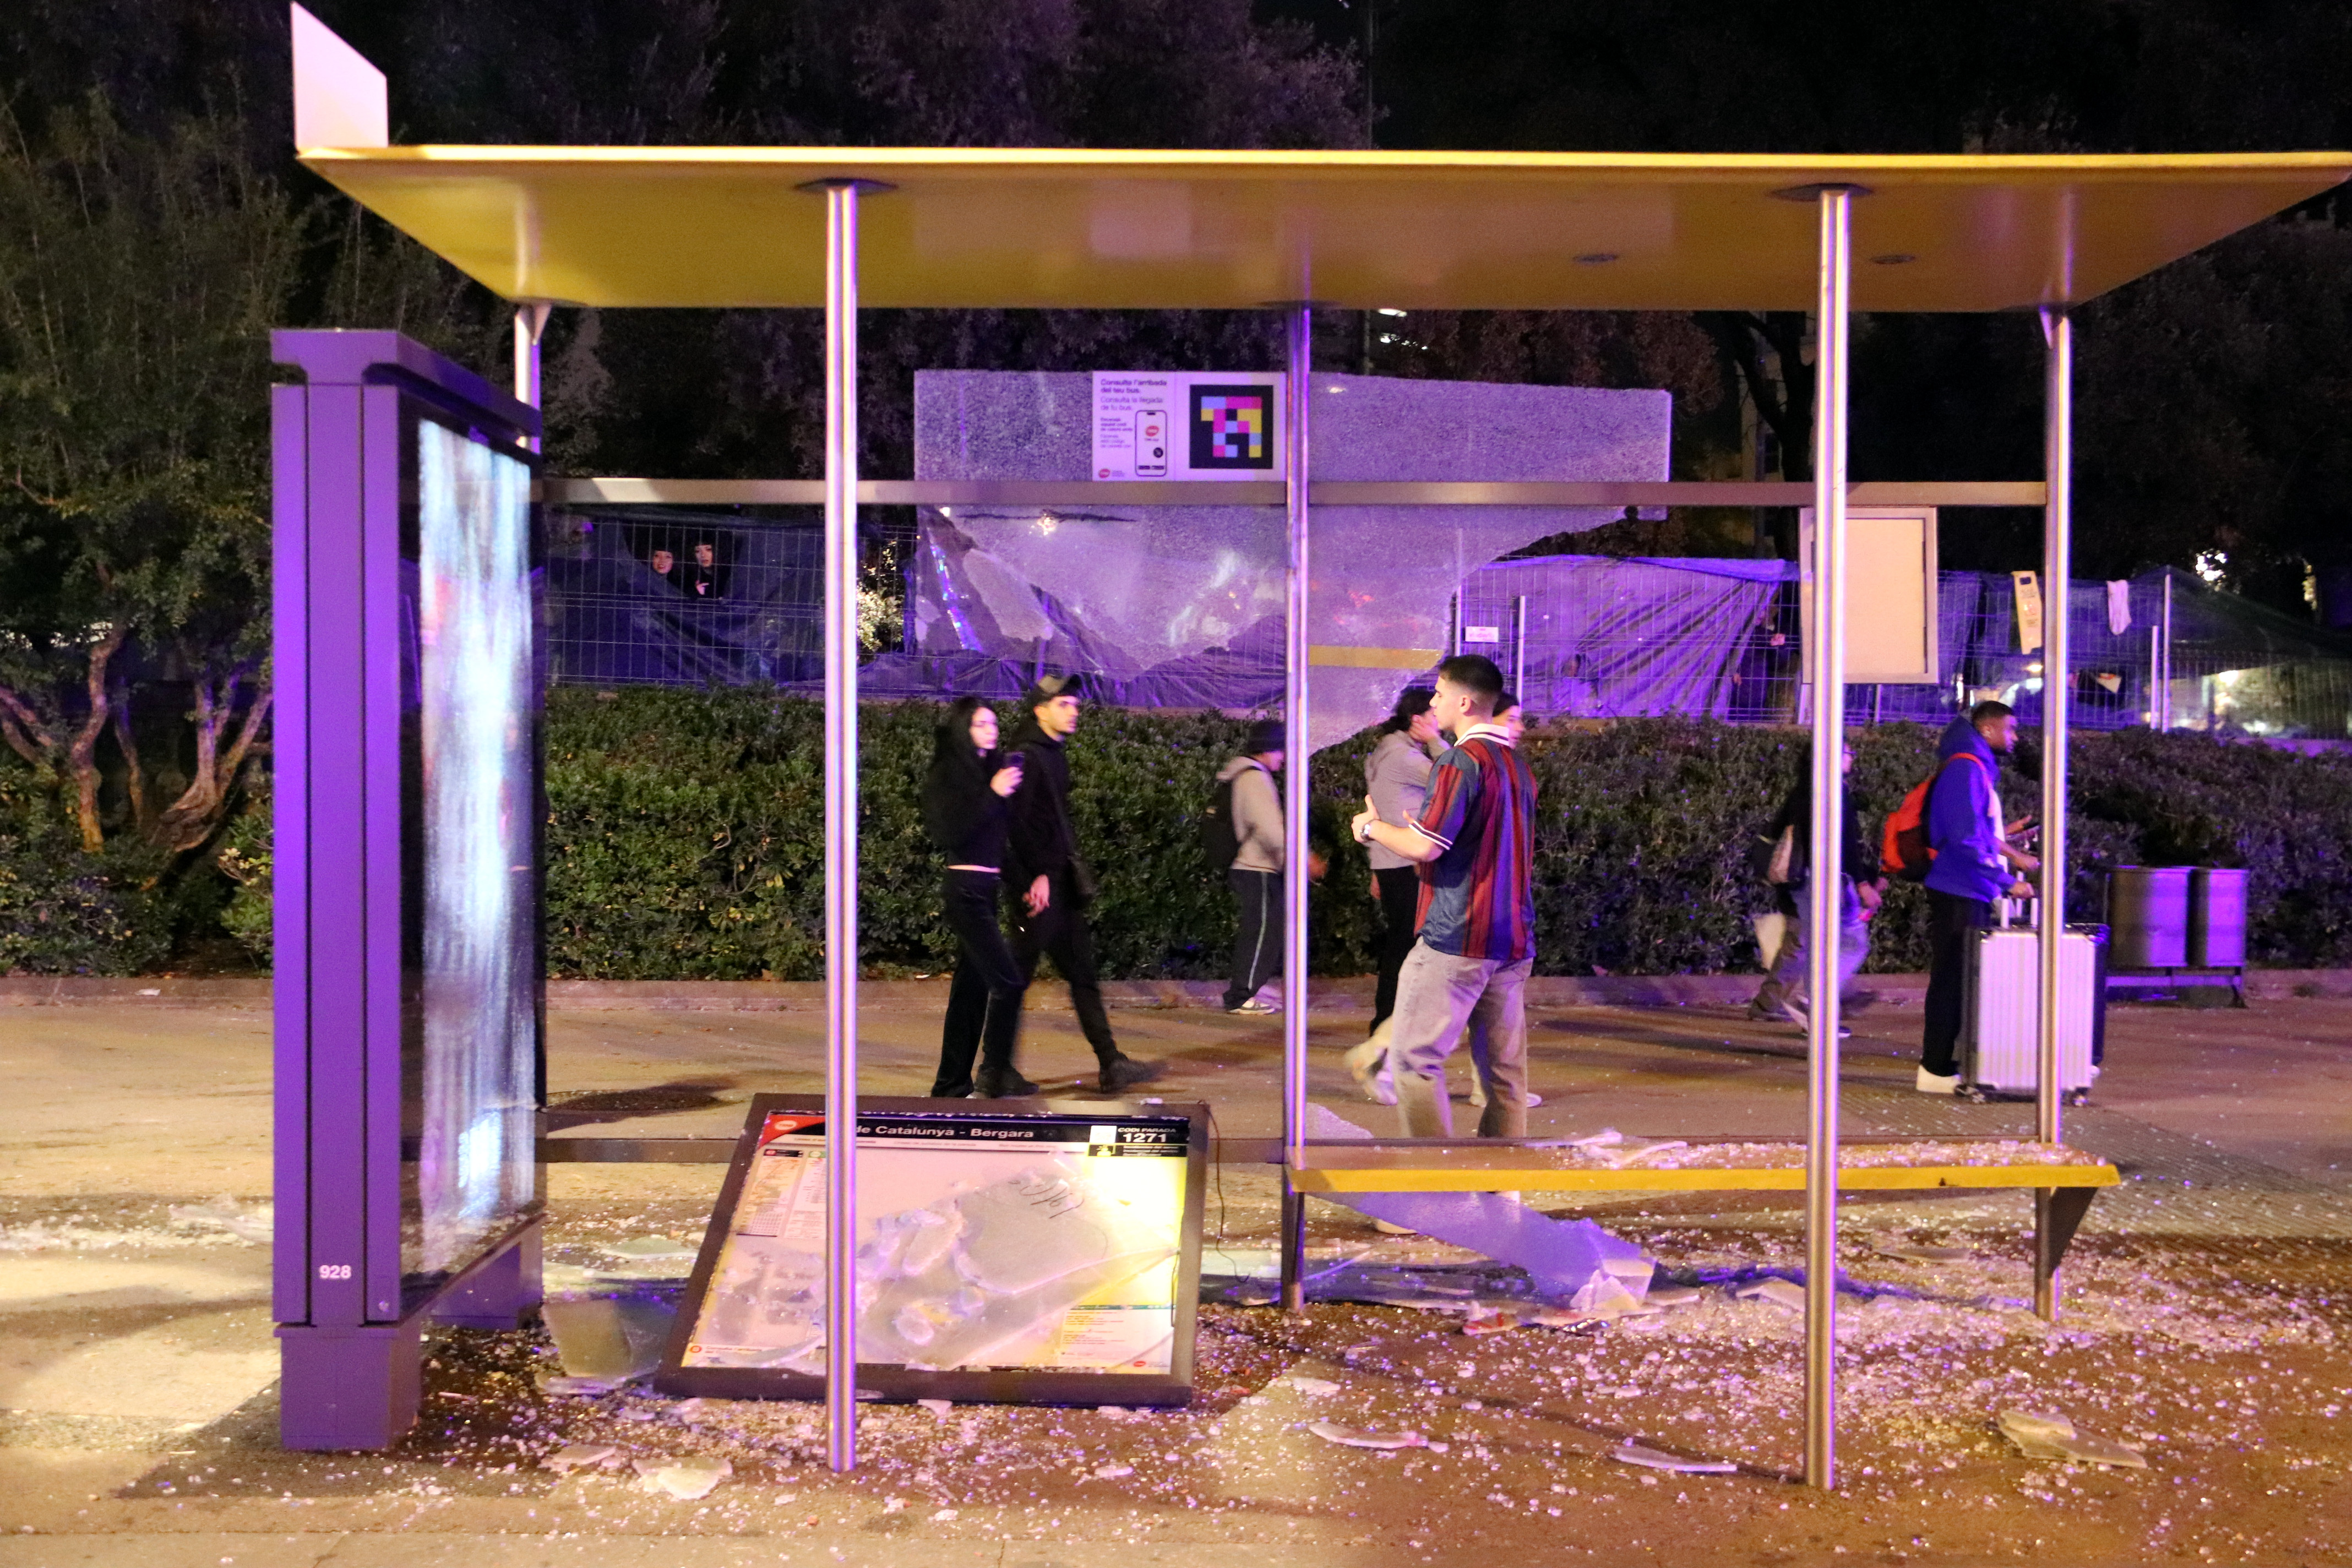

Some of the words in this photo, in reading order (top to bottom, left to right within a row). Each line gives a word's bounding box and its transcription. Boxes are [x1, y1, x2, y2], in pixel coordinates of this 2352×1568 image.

[875, 1125, 955, 1136] Catalunya
[971, 1128, 1035, 1139] Bergara
[1123, 1133, 1167, 1142] 1271
[319, 1265, 352, 1279] 928
